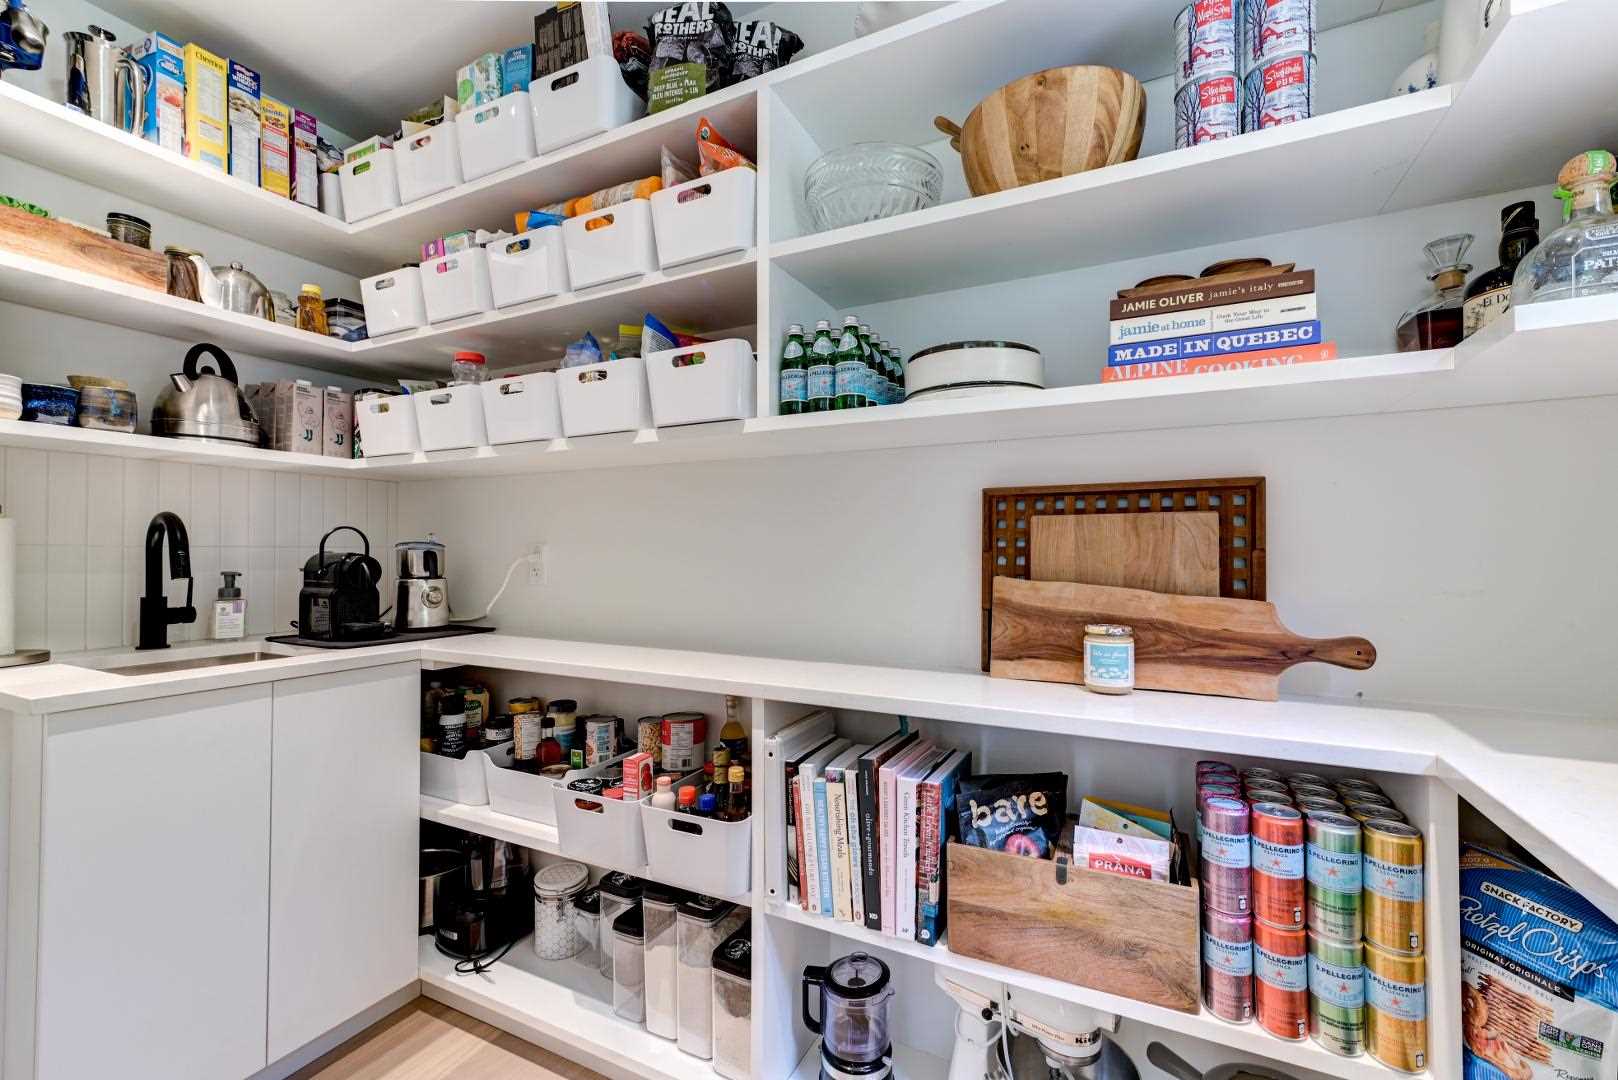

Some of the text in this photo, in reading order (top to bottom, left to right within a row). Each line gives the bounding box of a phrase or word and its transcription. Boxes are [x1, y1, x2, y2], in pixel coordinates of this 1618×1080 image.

[655, 20, 714, 36] ROTHERS
[1121, 301, 1156, 313] JAMIE
[1160, 292, 1204, 307] OLIVER
[1208, 286, 1245, 300] jamie's
[1250, 283, 1273, 294] italy
[1115, 325, 1313, 362] MADE IN QUEBEC
[1118, 322, 1159, 340] jamie
[1172, 317, 1206, 330] home
[1110, 359, 1189, 381] ALPINE
[1194, 355, 1303, 374] COOKING
[834, 793, 846, 858] Nourishing Meals
[969, 791, 1048, 829] bare
[1484, 884, 1579, 928] SNACK FACTORY
[1522, 928, 1607, 980] Crisps
